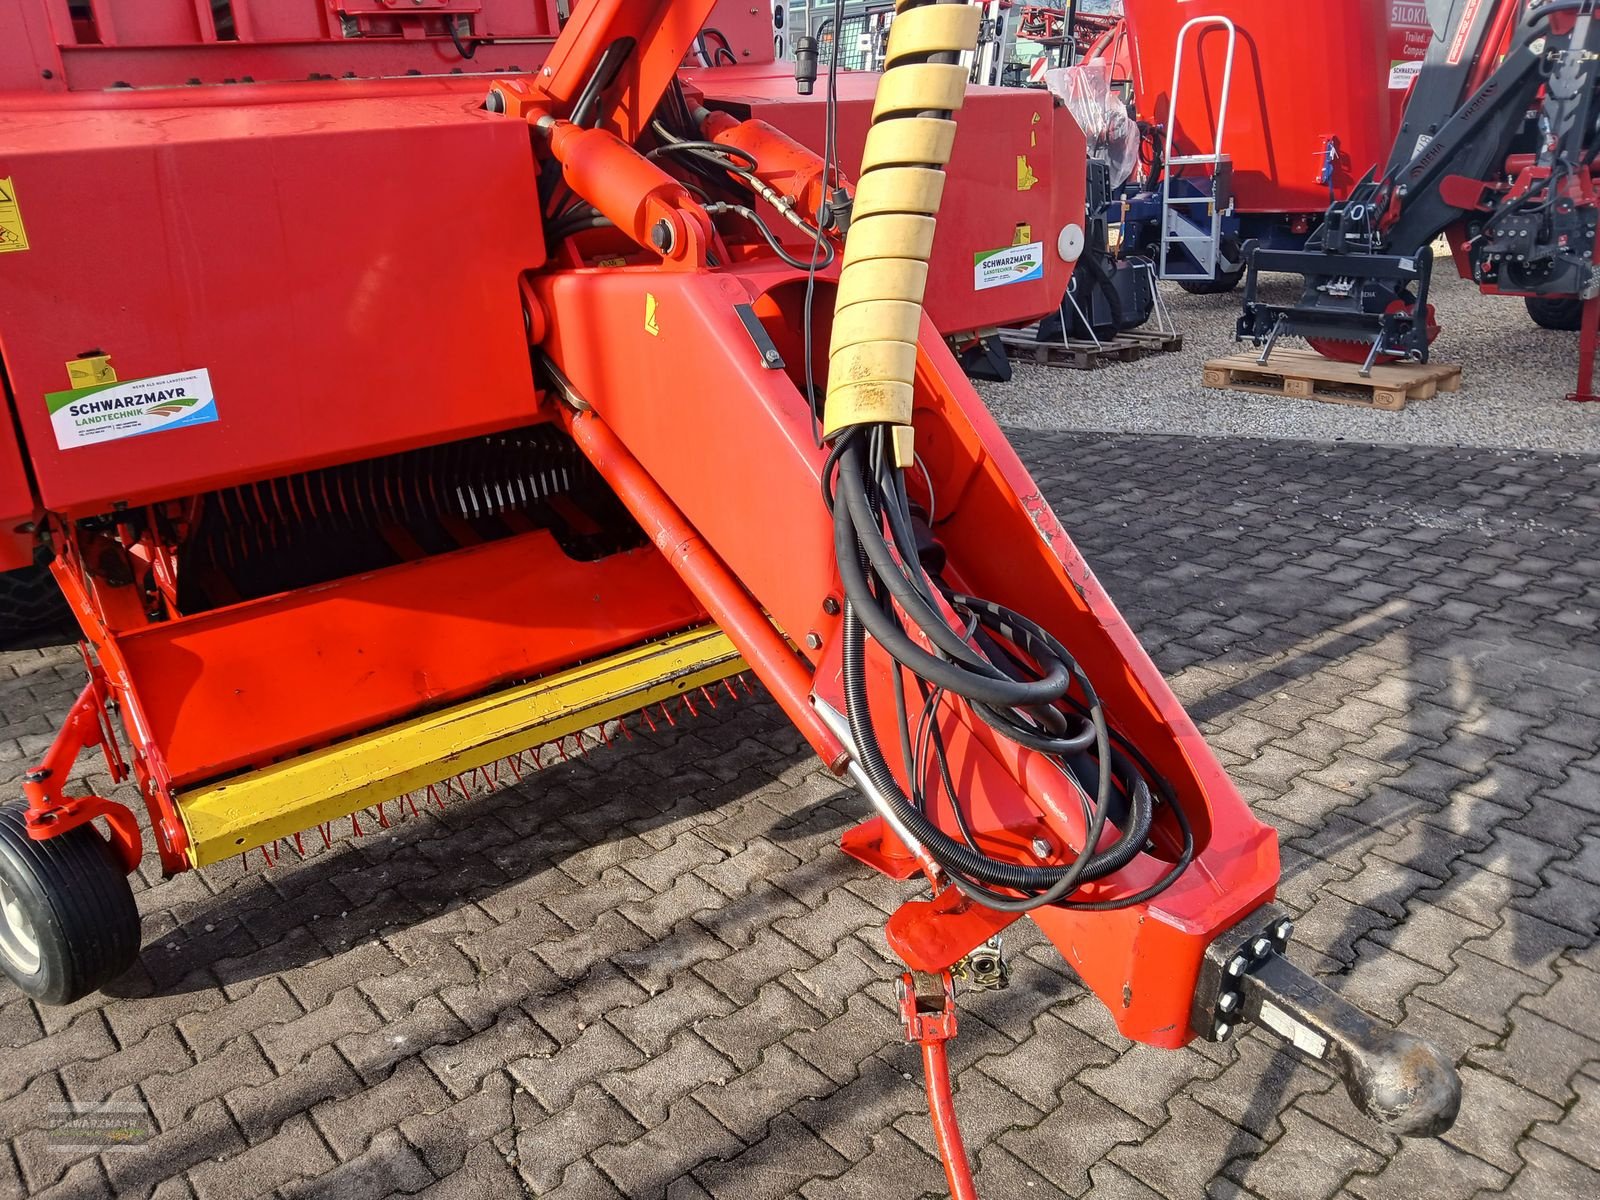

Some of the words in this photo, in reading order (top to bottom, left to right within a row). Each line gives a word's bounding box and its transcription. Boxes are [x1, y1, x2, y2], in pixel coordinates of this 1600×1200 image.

[982, 253, 1032, 269] SCHWARZMAYR
[69, 387, 185, 417] SCHWARZMAYR
[74, 408, 144, 427] LANDTECHNIK
